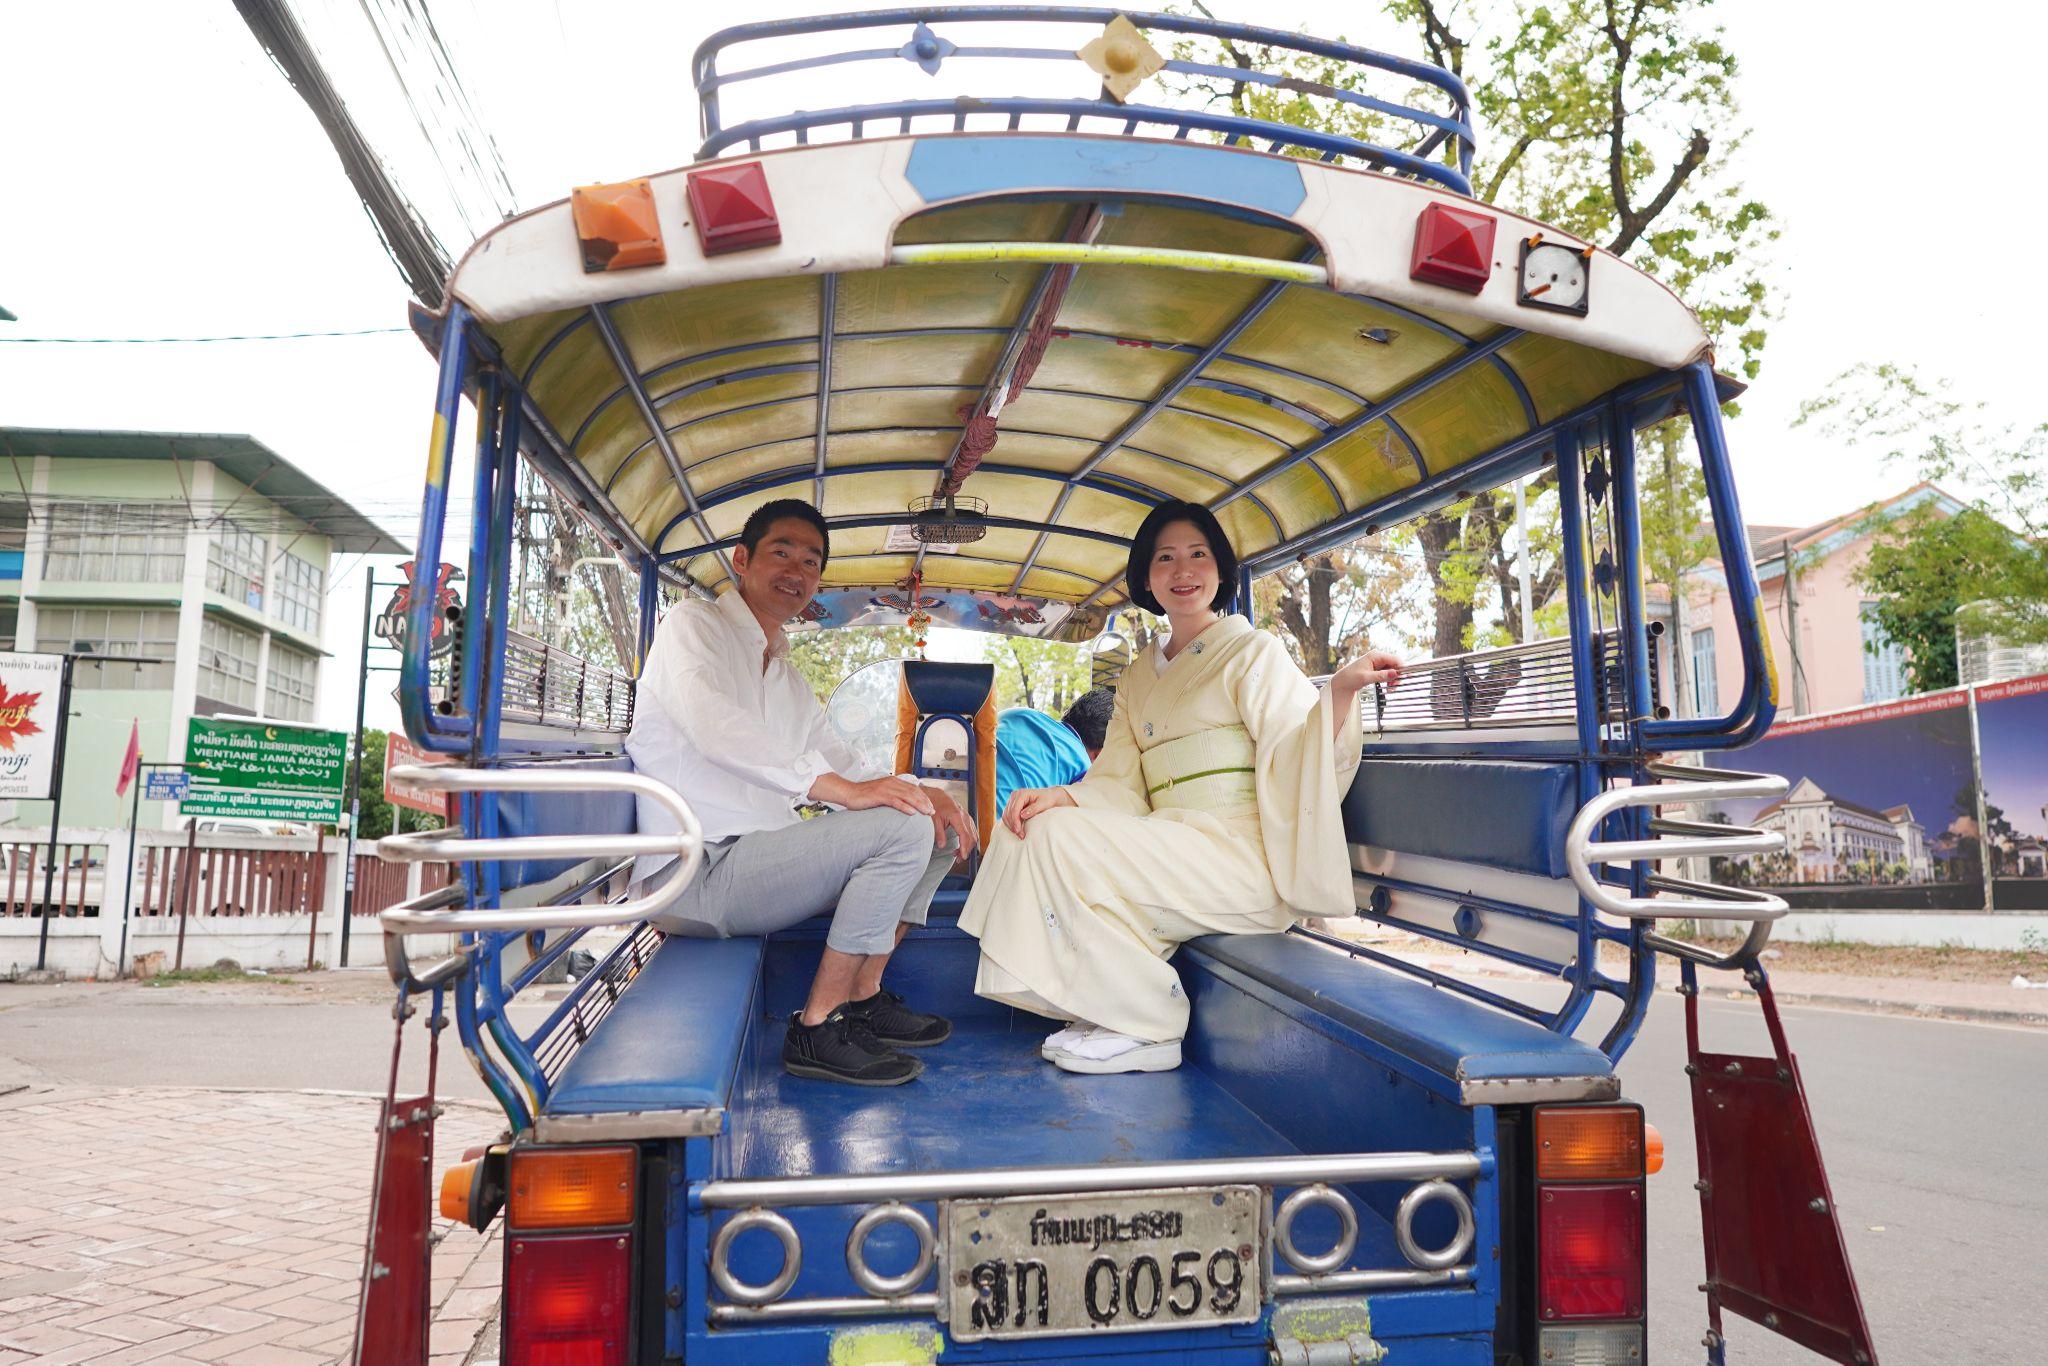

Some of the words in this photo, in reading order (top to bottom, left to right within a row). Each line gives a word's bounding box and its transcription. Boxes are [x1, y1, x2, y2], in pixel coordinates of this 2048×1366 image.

[194, 748, 258, 761] VIENTIANE
[261, 754, 296, 765] JAMIA
[298, 757, 340, 768] MASJID
[183, 805, 214, 814] MUSLIM
[216, 807, 266, 817] ASSOCIATION
[268, 809, 306, 819] VIENTIANE
[308, 812, 337, 821] CAPITAL
[1084, 1247, 1243, 1323] 0059
